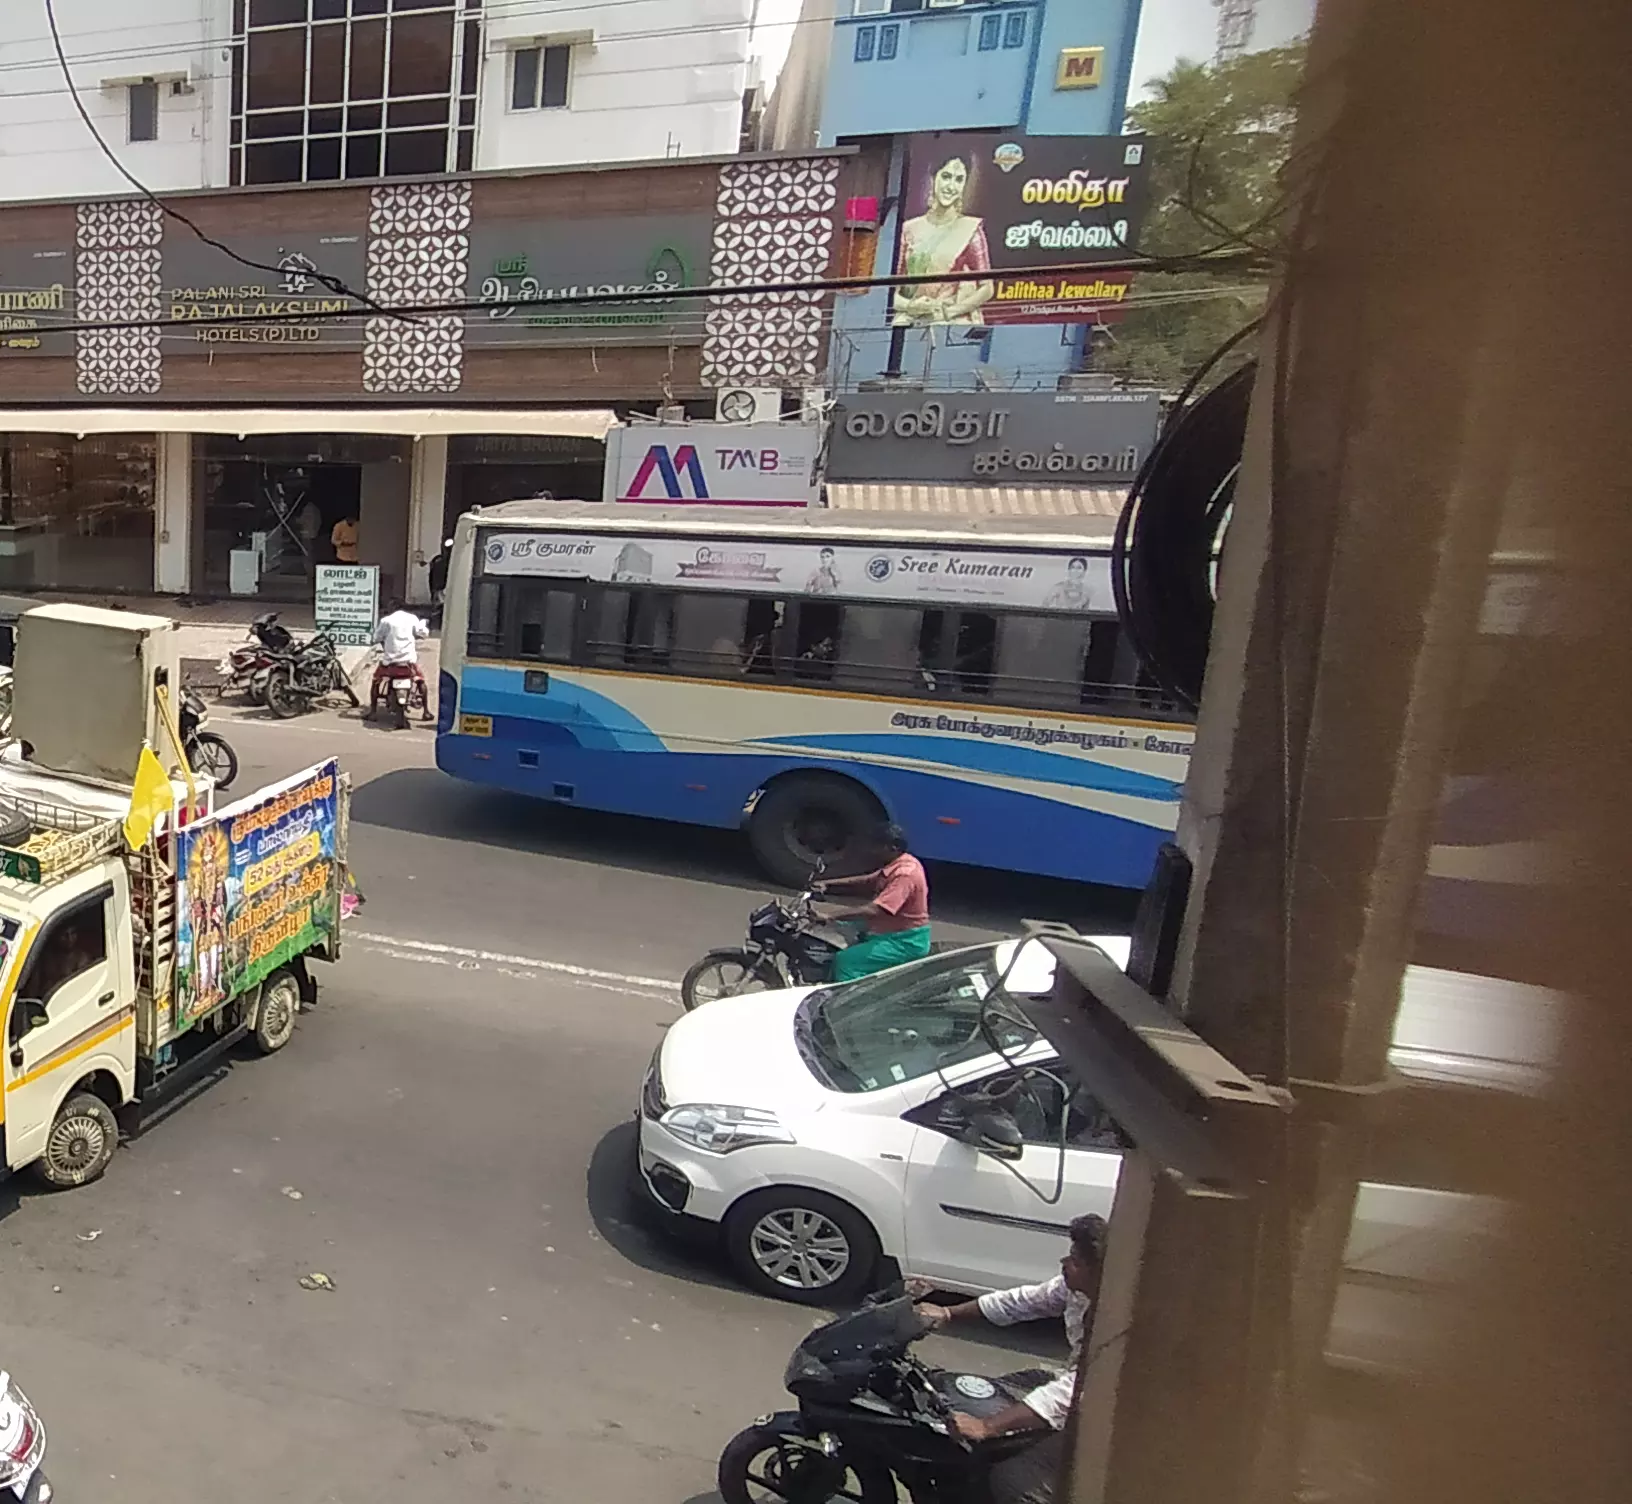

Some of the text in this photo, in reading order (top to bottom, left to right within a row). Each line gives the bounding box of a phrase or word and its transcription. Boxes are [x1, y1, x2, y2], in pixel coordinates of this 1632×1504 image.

[1022, 169, 1130, 213] லலிதா
[171, 285, 267, 301] PALANI SRI
[996, 280, 1127, 302] Lalithaa Jewellary
[196, 329, 259, 342] HOTELS
[289, 327, 320, 340] LTD
[845, 399, 1011, 445] லலிதா
[714, 448, 780, 472] TMB
[536, 540, 596, 557] குமரன்
[897, 555, 1034, 579] Sree Kumaran
[328, 632, 367, 645] ODGE
[890, 712, 932, 730] அரசு
[250, 866, 264, 886] 52
